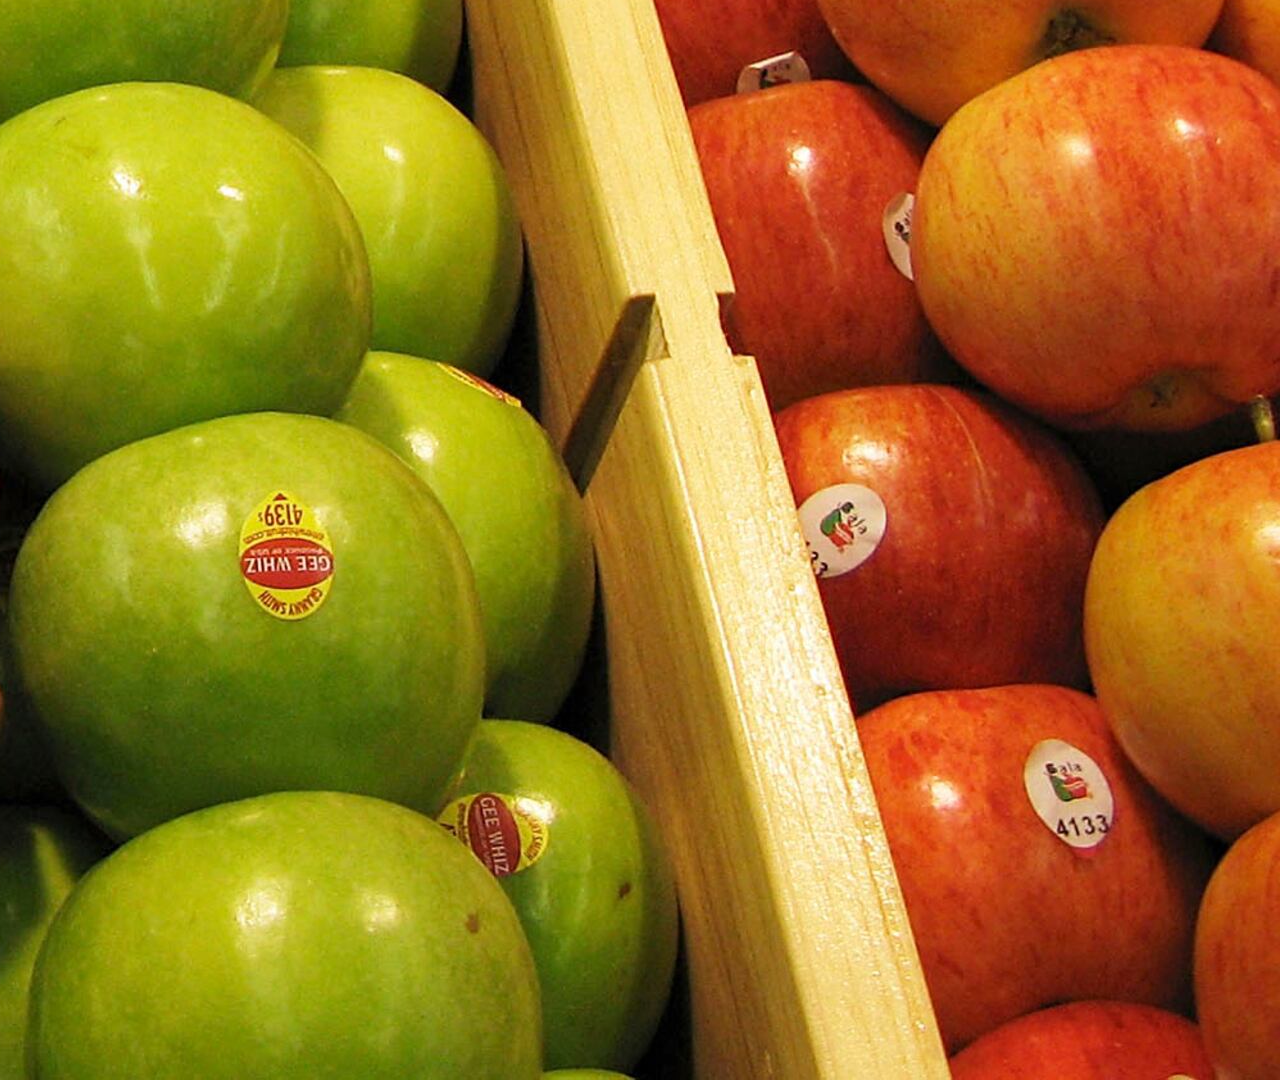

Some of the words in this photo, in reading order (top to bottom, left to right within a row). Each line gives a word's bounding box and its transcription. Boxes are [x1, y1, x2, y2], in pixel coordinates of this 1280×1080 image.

[264, 503, 303, 527] 4139
[246, 556, 293, 574] WHIZ
[297, 555, 332, 572] GEE
[288, 587, 324, 616] GRANNY
[479, 797, 500, 827] GEE
[1056, 814, 1111, 838] 4133
[489, 832, 510, 876] WHIZ
